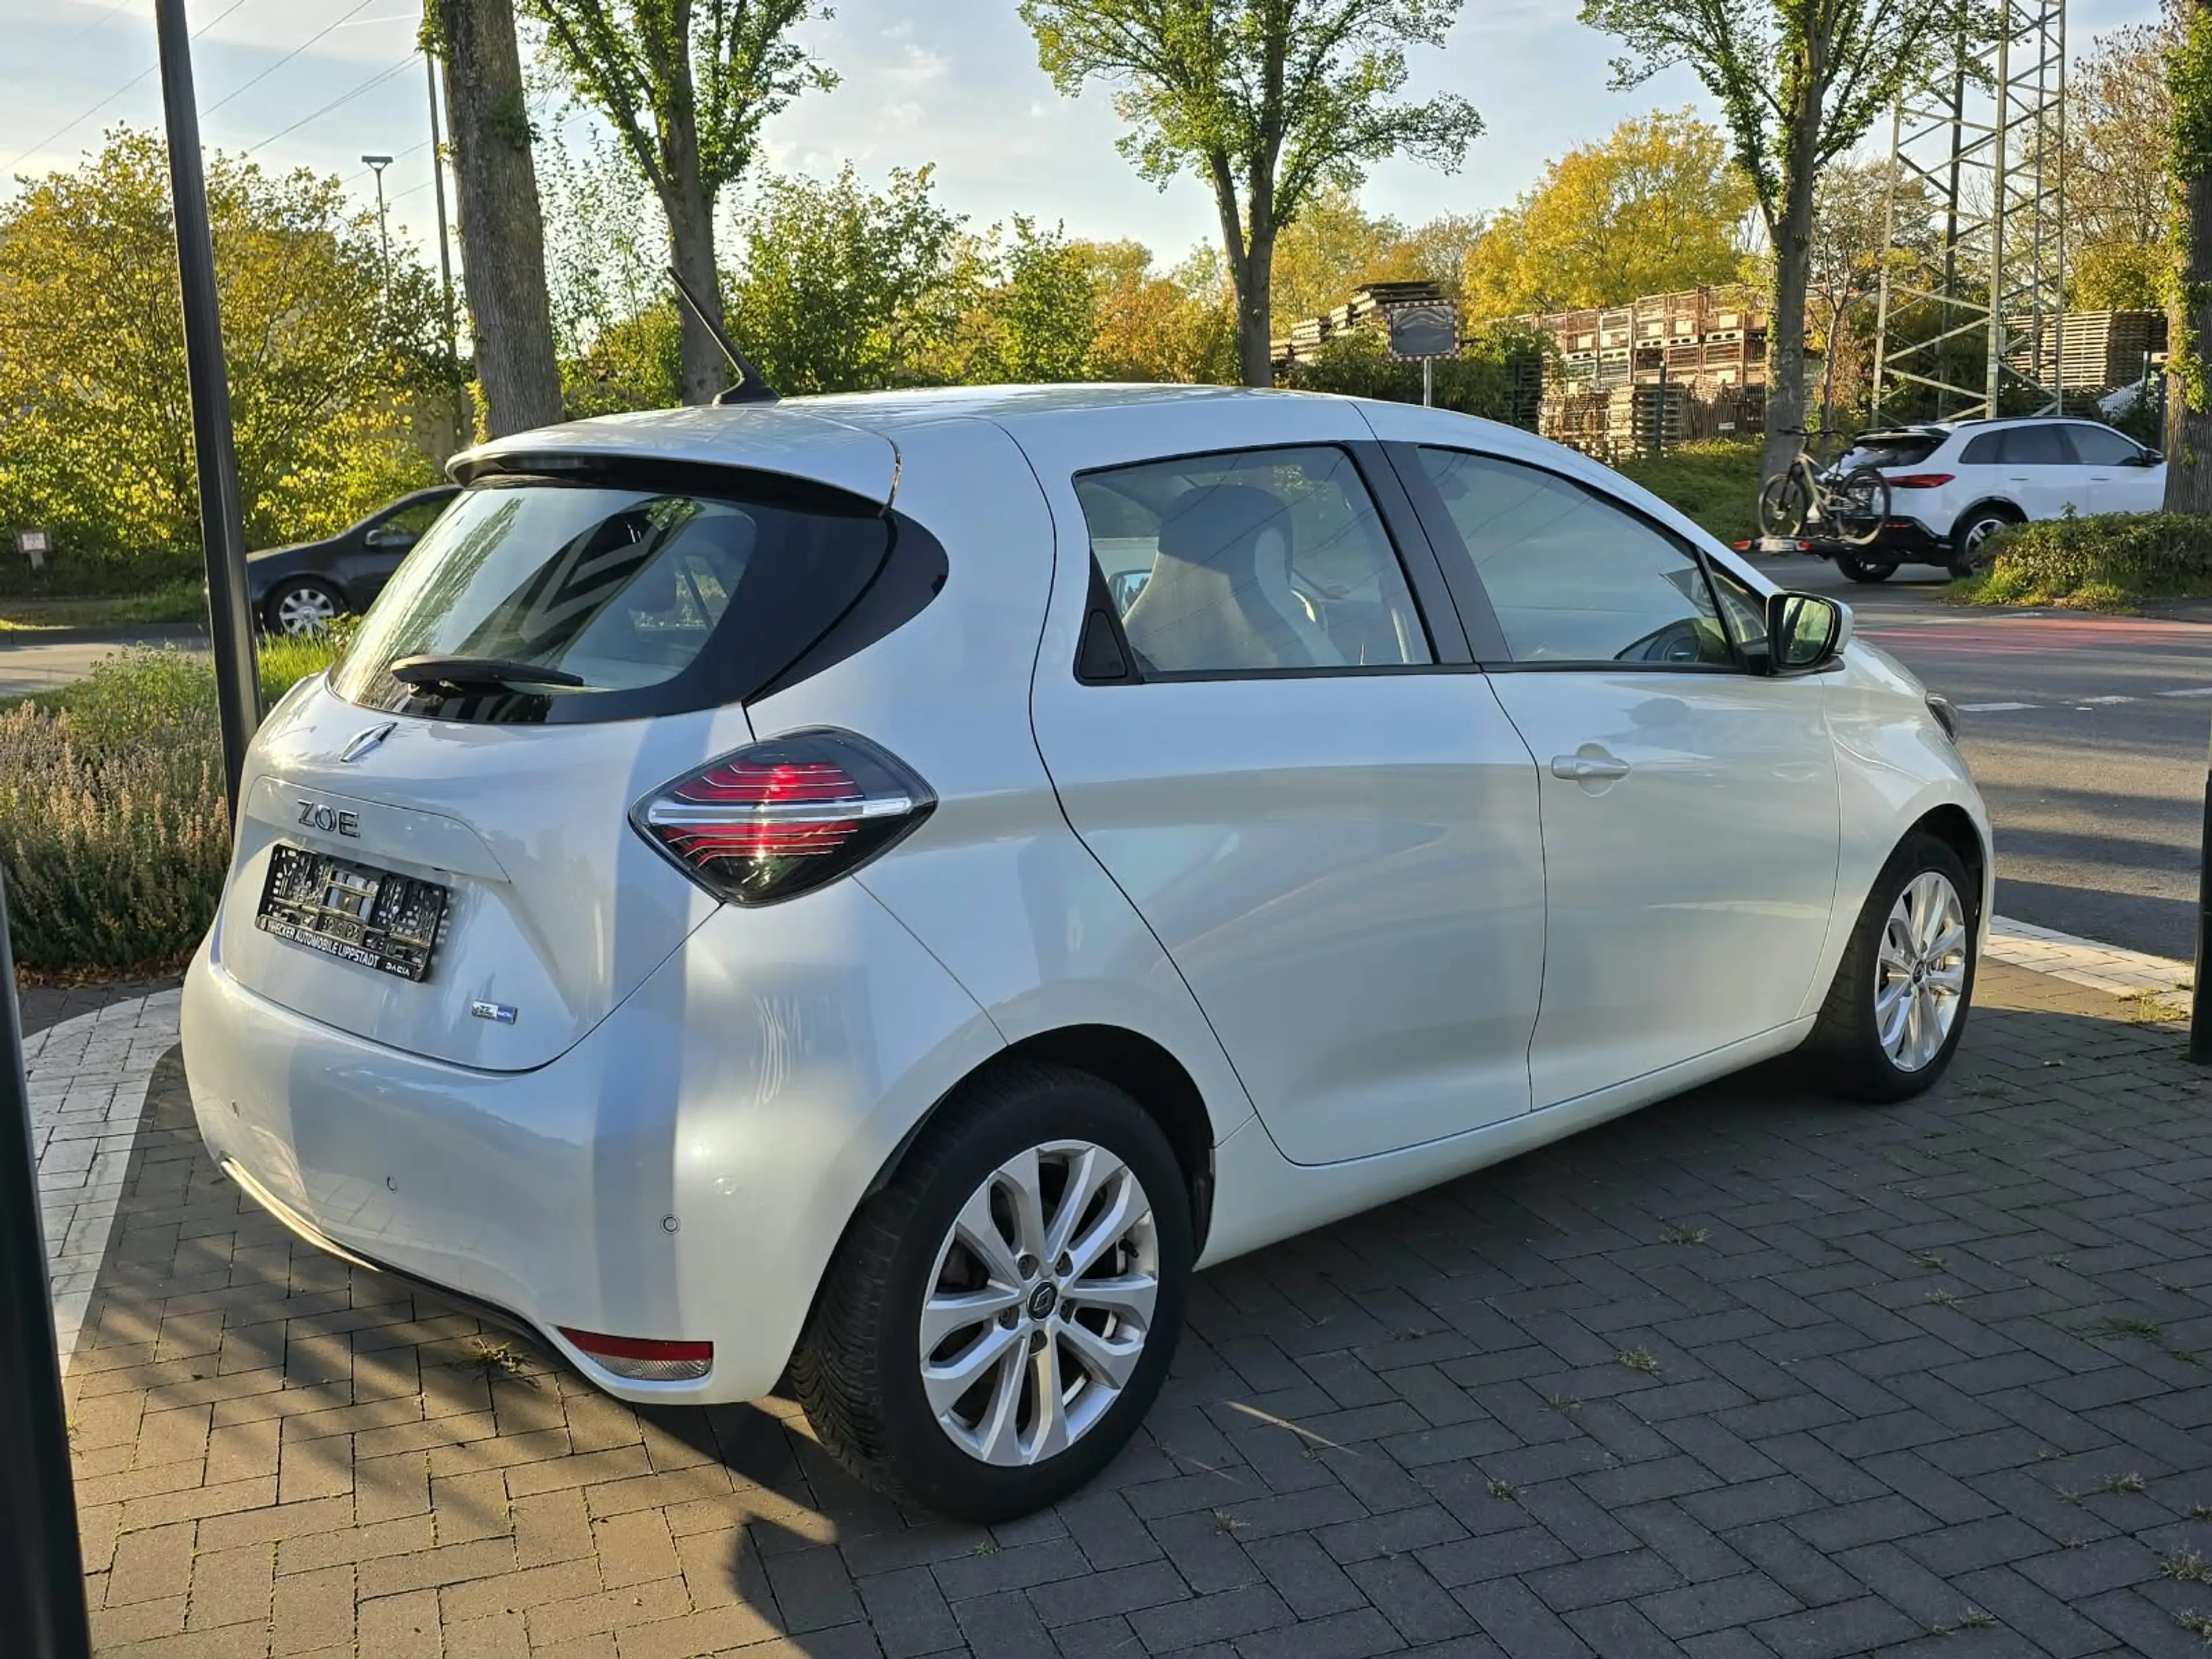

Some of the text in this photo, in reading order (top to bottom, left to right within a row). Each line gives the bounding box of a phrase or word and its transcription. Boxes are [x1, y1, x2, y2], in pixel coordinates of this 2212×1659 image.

[297, 798, 360, 838] ZOE
[294, 929, 339, 955] AUTOMOBILE
[338, 944, 380, 968] LIPPSTADT
[385, 961, 410, 976] DACIA
